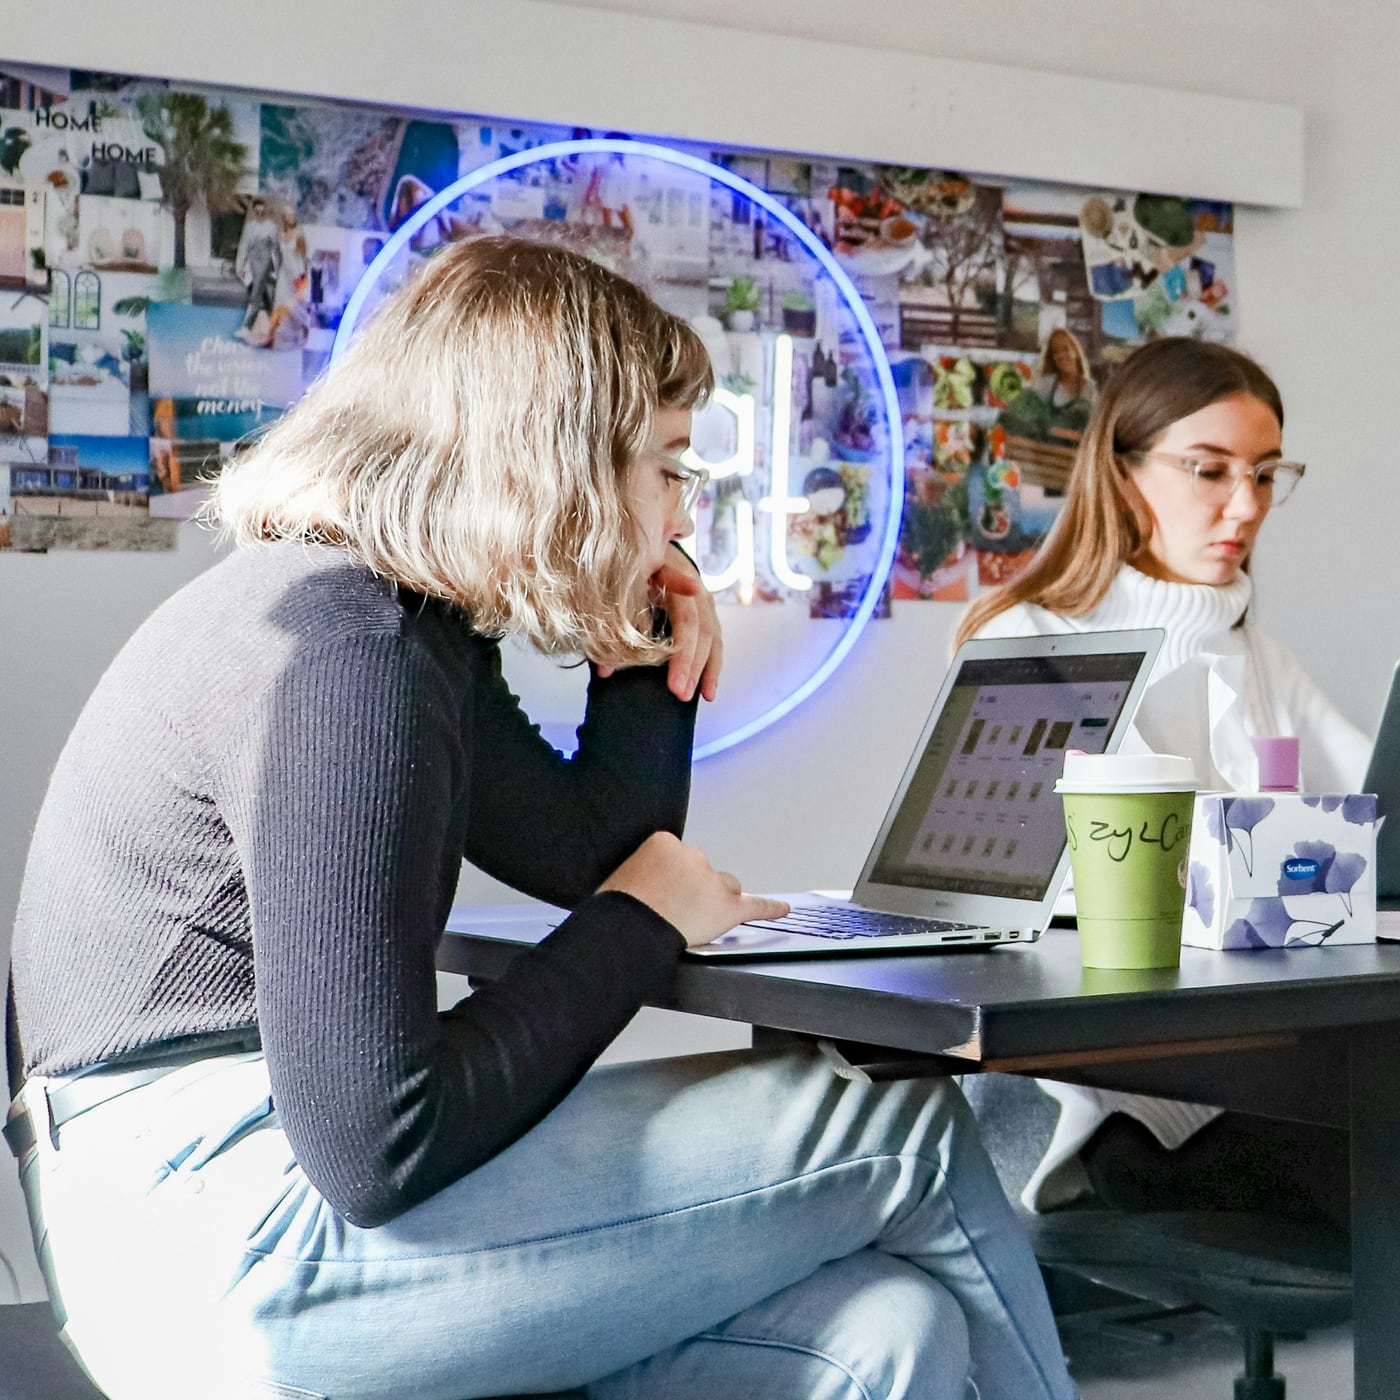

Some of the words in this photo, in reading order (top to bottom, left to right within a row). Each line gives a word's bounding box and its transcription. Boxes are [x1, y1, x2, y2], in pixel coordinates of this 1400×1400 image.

[35, 108, 102, 133] HOME
[91, 141, 157, 164] HOME
[196, 398, 262, 421] money
[1286, 863, 1316, 873] Sorbent
